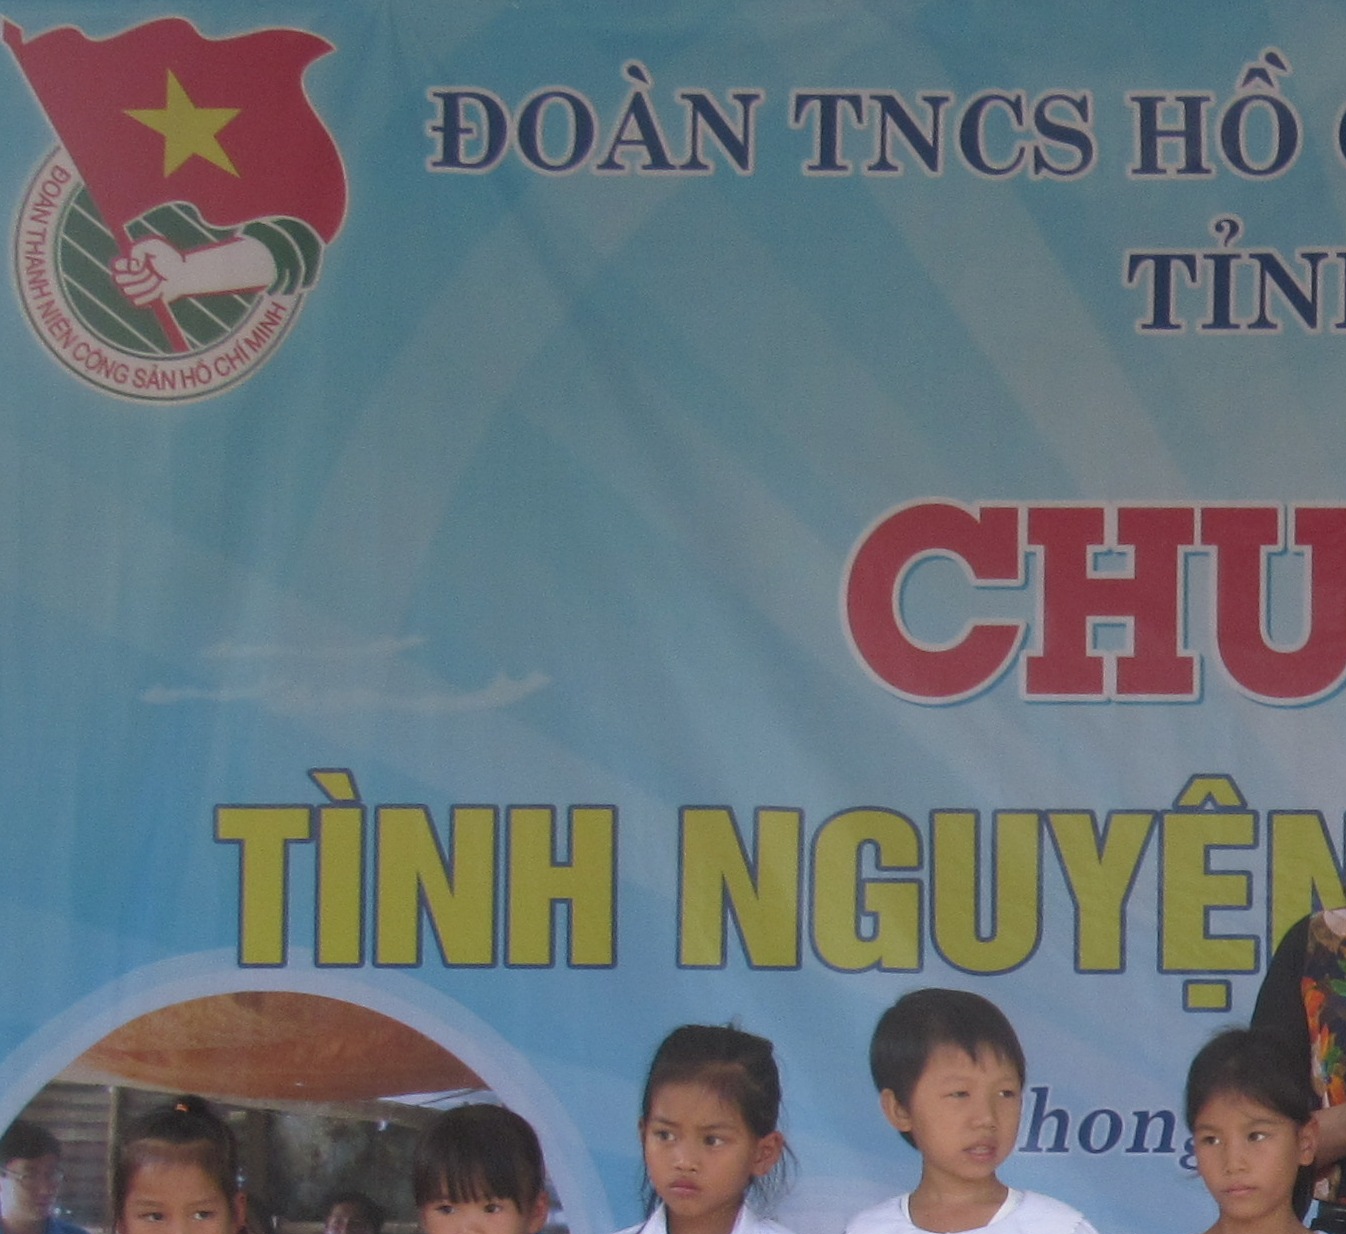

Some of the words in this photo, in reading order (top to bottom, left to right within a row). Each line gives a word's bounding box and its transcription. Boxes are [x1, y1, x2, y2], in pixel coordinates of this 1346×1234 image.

[430, 64, 762, 172] ĐOÀN
[795, 92, 1095, 177] TNCS
[1129, 50, 1299, 177] HỒ
[25, 226, 53, 300] THANH
[132, 363, 176, 391] SẢN
[244, 301, 288, 354] MINH
[213, 769, 617, 968] TÌNH
[1018, 1086, 1198, 1174] hon
